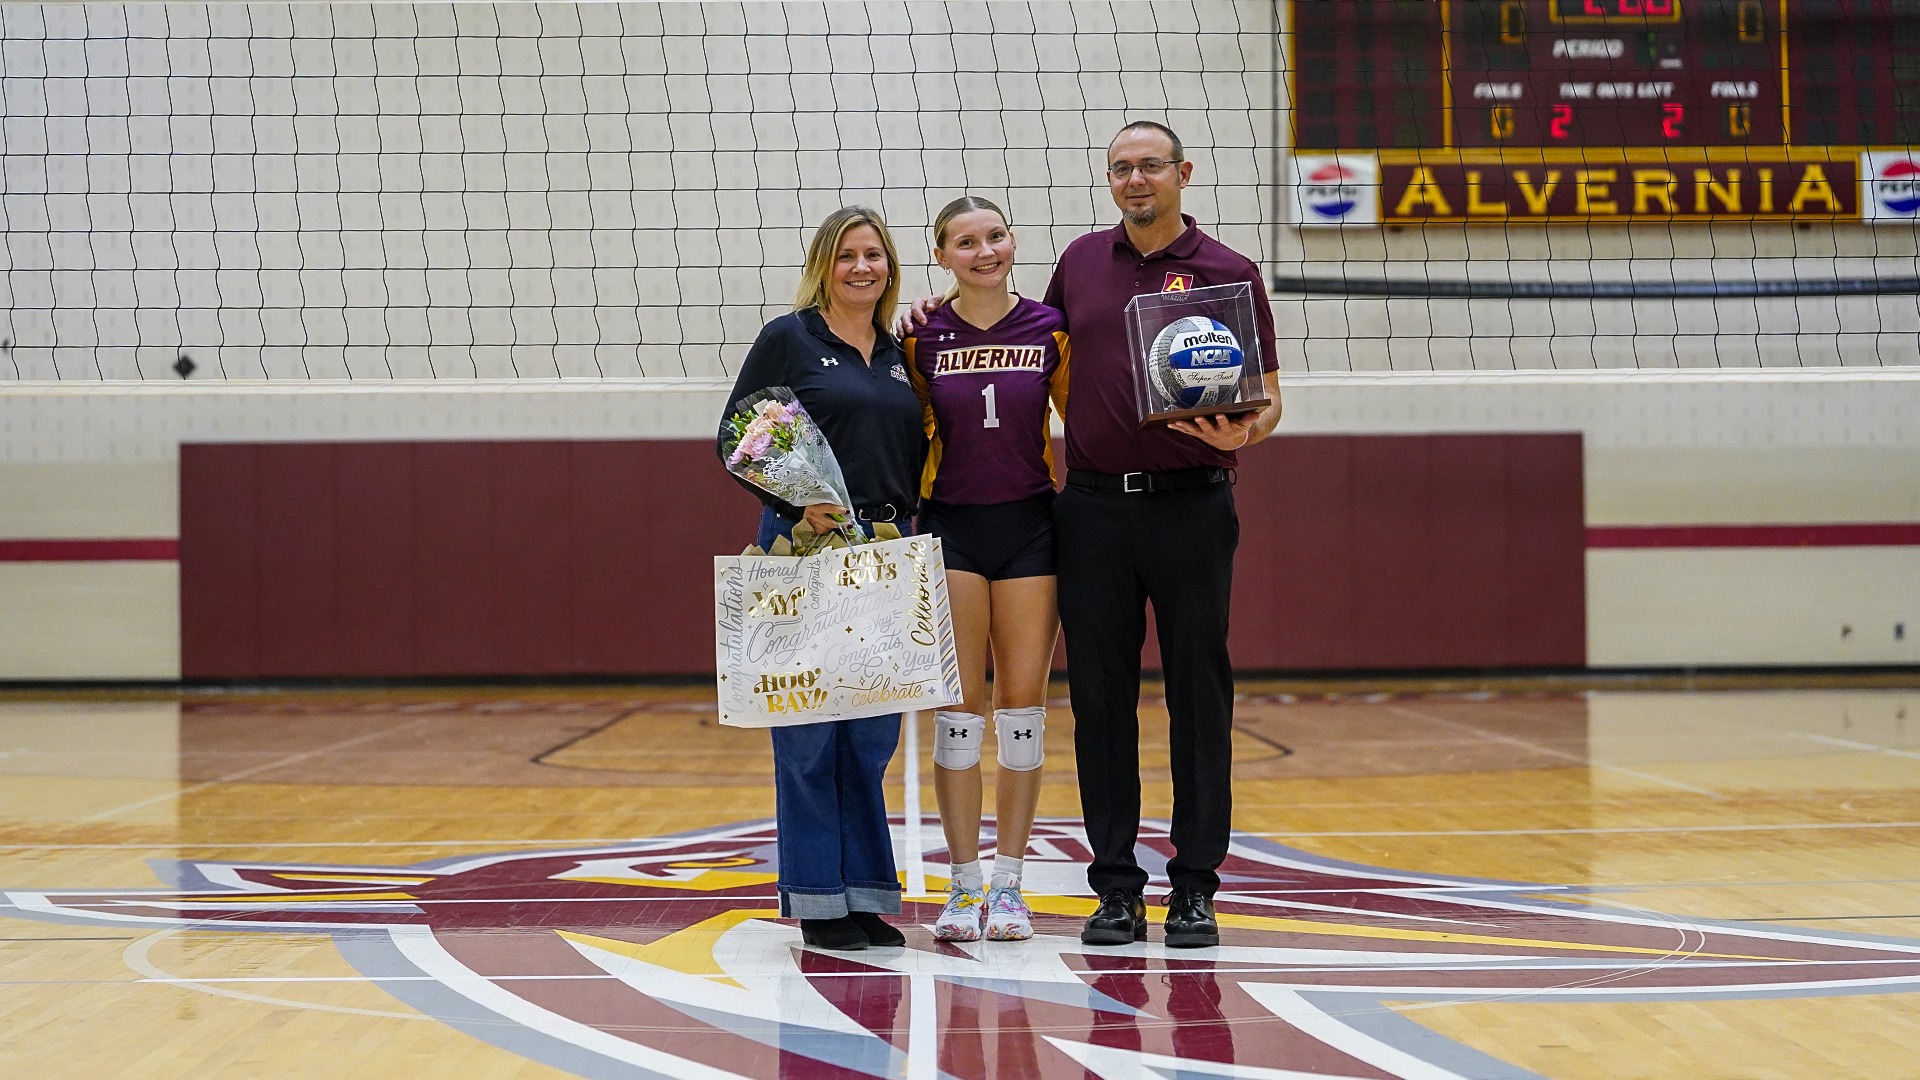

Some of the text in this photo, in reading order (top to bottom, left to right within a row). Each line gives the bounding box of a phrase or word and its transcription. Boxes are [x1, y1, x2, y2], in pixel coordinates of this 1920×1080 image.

[1550, 104, 1572, 138] 2
[1661, 103, 1683, 138] 2
[1393, 164, 1842, 215] ALVERNIA
[1164, 276, 1187, 294] A
[1183, 332, 1233, 348] molten
[936, 348, 1044, 375] ALVERNIA
[1190, 349, 1232, 367] NCAA
[1187, 371, 1211, 383] Super
[981, 383, 1000, 429] 1
[747, 560, 803, 584] Hooray
[904, 540, 936, 647] Celebrate
[718, 558, 757, 714] Congratulations
[746, 584, 903, 666] Congratulations
[870, 612, 897, 635] Yay
[824, 629, 904, 678] Congrats
[902, 650, 941, 677] Yay
[766, 687, 828, 714] RAY!!
[833, 673, 938, 708] celebrate
